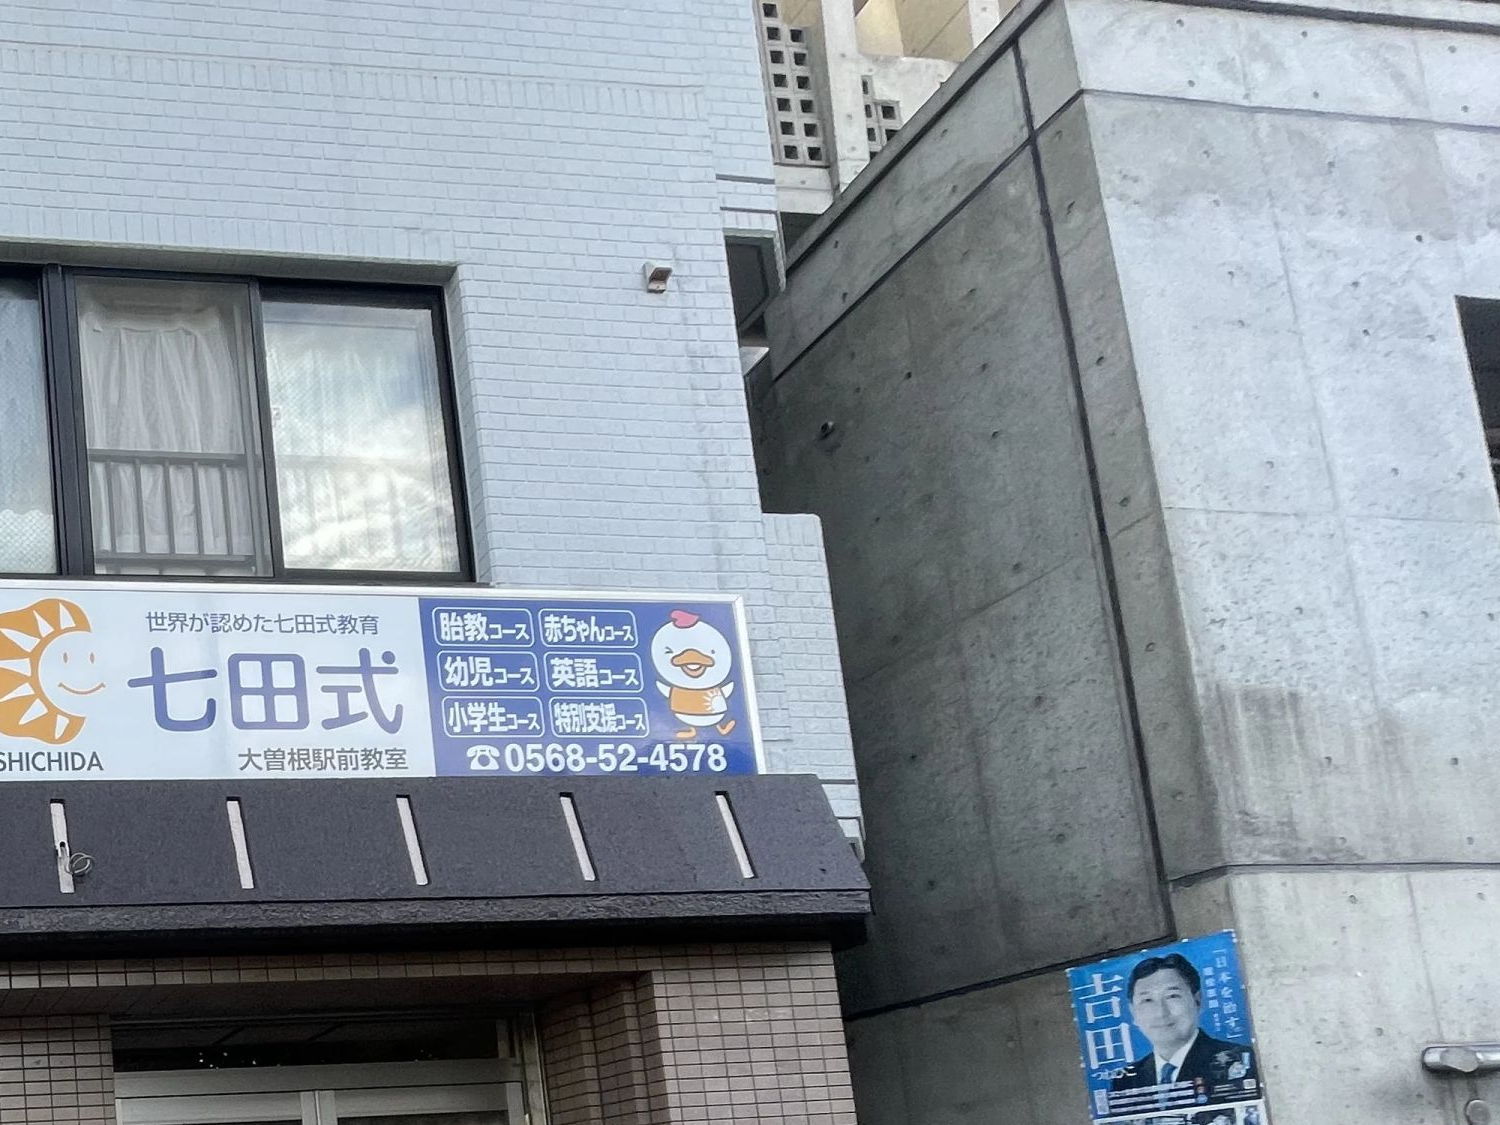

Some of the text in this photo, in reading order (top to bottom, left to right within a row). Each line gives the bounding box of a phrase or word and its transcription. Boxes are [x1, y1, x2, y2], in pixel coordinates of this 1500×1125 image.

[145, 611, 380, 635] 世界が認めた七田式教育
[439, 612, 530, 642] 胎教コース
[544, 614, 634, 643] 赤ちゃんコース
[444, 656, 535, 688] 幼児コース
[550, 657, 639, 688] 英語コース
[127, 646, 404, 734] 七田式
[448, 702, 540, 732] 小学生コース
[555, 702, 646, 733] 特別支援コース
[238, 746, 409, 772] 大曽根駅前教室
[504, 742, 728, 773] 0568-52-4578
[1074, 973, 1136, 1070] 吉田
